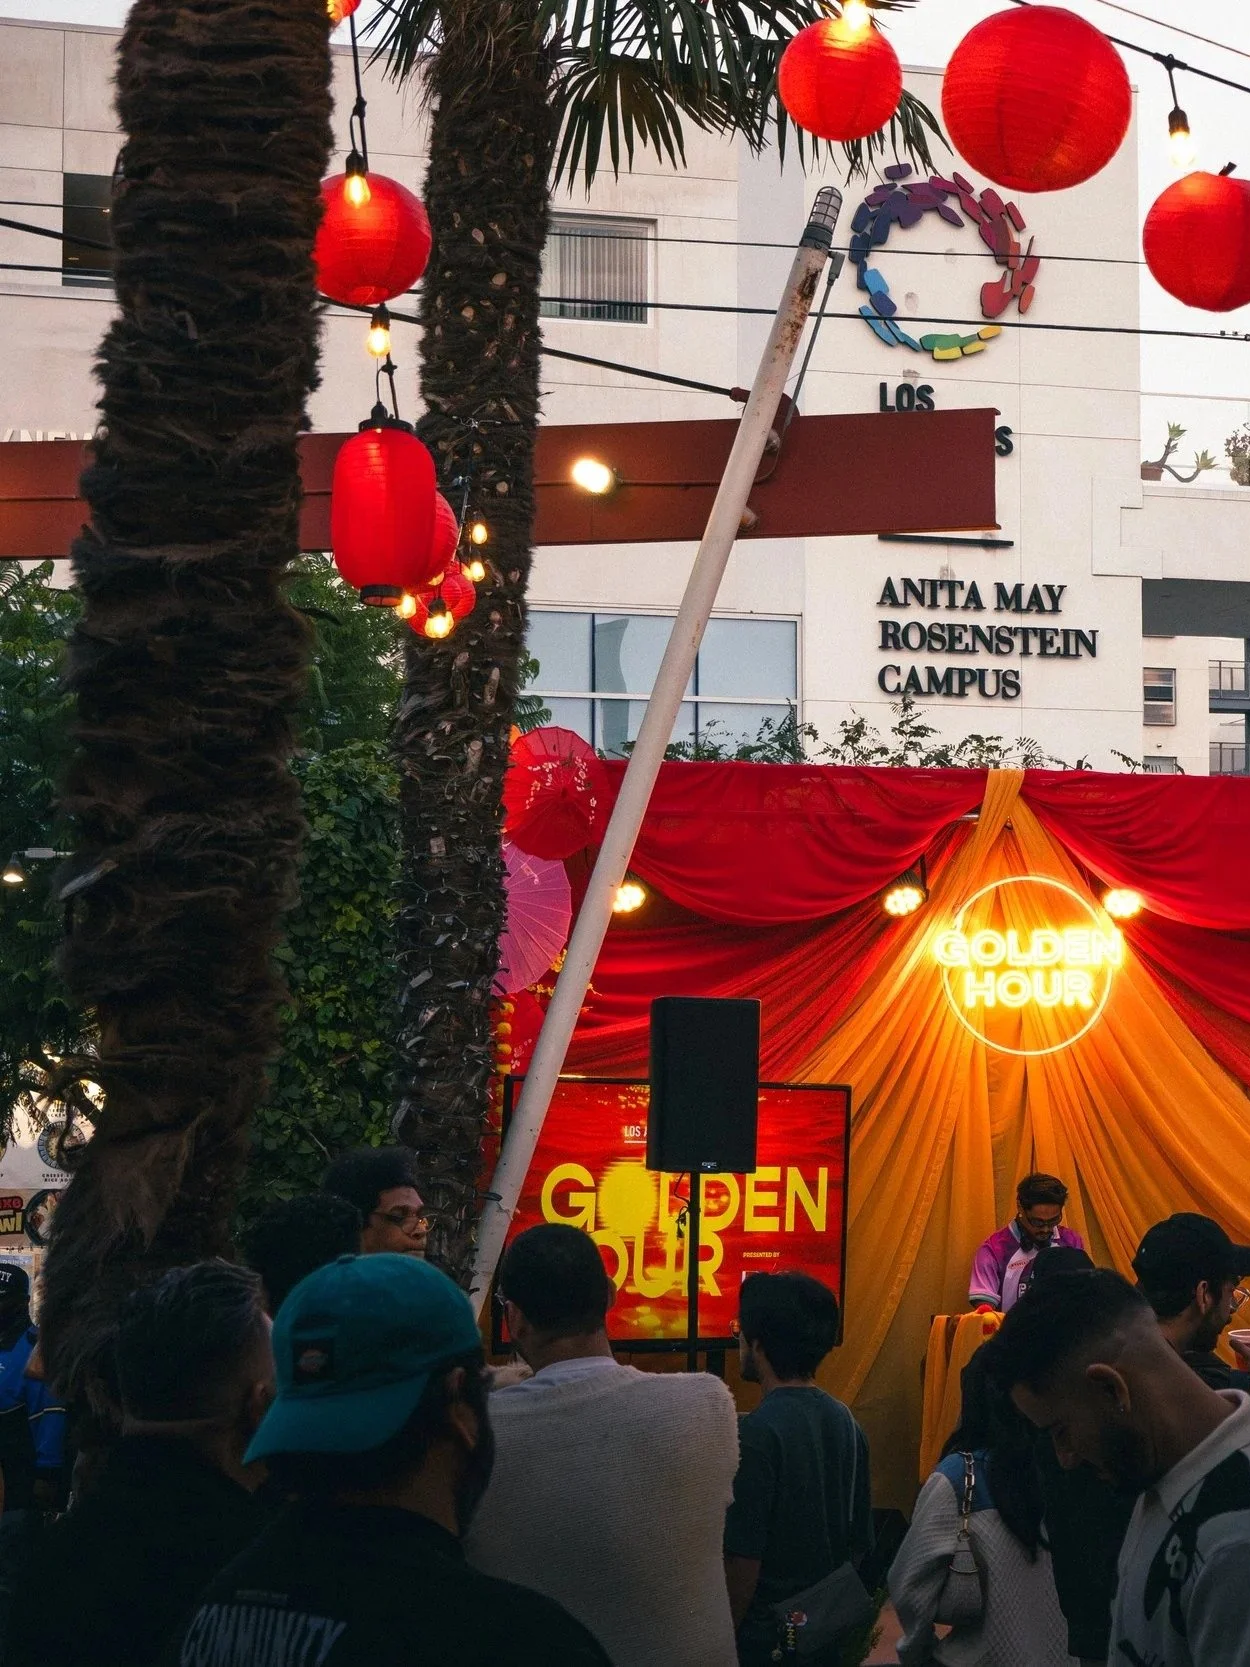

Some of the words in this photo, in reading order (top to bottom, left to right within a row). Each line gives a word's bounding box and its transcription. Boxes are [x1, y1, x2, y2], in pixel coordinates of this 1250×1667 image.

[879, 382, 935, 412] LOS
[877, 576, 986, 610] ANITA
[994, 582, 1067, 613] MAY
[878, 620, 1099, 658] ROSENSTEIN
[877, 664, 1021, 699] CAMPUS
[935, 930, 1122, 966] GOLDEN
[964, 970, 1093, 1008] HOUR
[624, 1125, 641, 1137] LOS
[541, 1163, 828, 1232] GOLDEN
[589, 1230, 723, 1298] OUR
